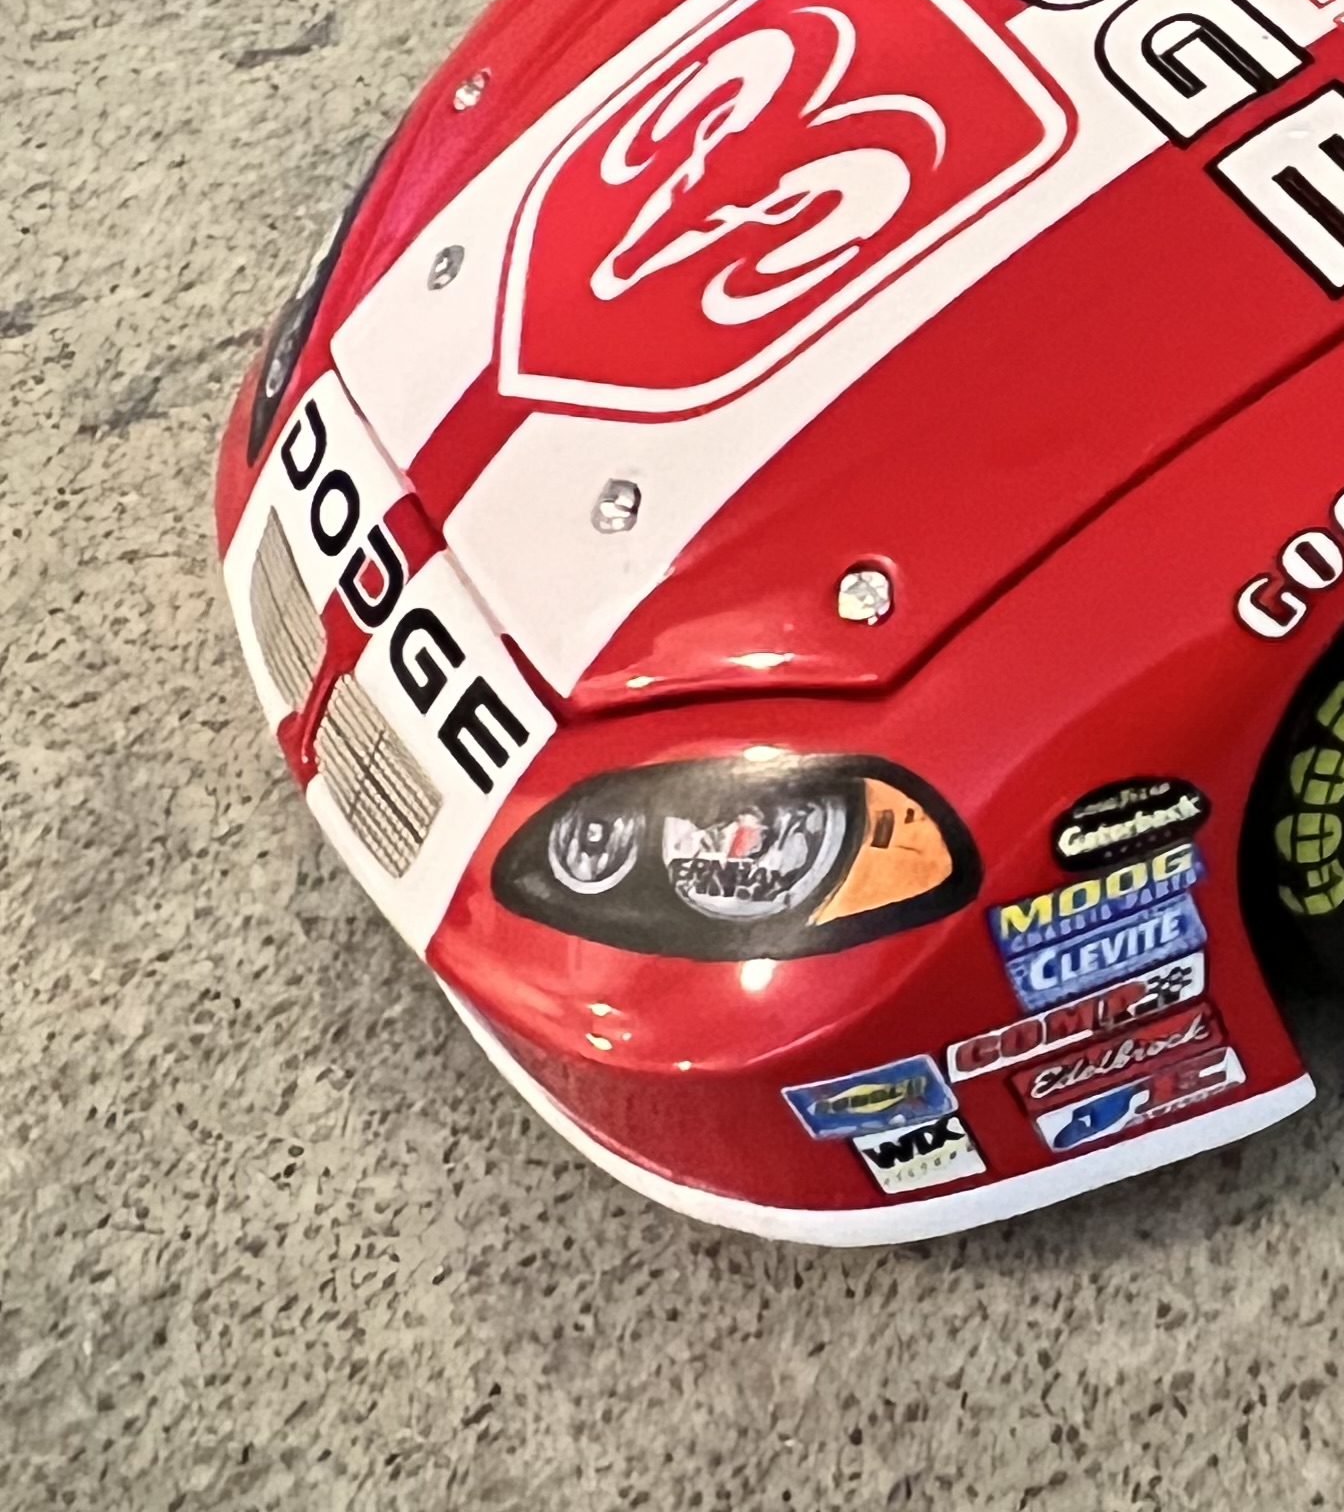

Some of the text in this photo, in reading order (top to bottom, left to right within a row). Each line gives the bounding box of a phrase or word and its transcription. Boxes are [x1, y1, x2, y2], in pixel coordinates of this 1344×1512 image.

[280, 398, 530, 795] DODGE
[1001, 843, 1193, 939] MOOG
[1029, 912, 1182, 991] CLEVITE
[861, 1113, 966, 1170] WIX
